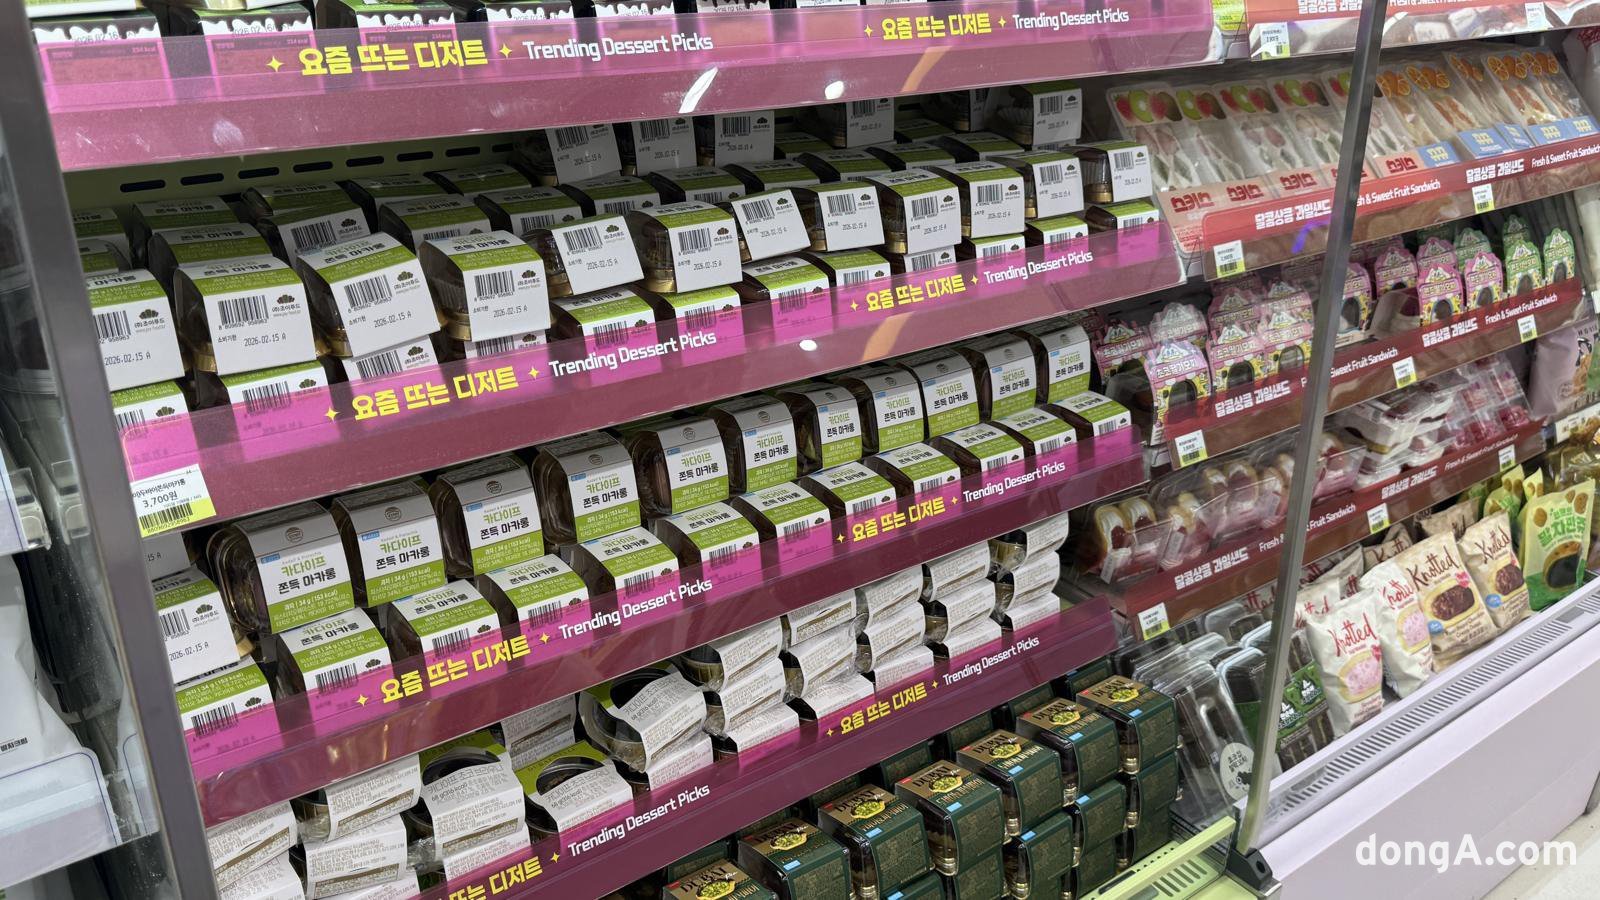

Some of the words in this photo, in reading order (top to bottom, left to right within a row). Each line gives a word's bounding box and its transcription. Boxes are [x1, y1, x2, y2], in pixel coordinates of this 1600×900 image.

[881, 17, 913, 40] 요즘
[916, 15, 946, 38] 뜨는
[949, 12, 992, 36] 디저트
[1012, 11, 1060, 31] Trending
[1060, 10, 1102, 28] Dessert
[1103, 9, 1129, 24] Picks
[298, 45, 353, 76] 요즘
[356, 43, 410, 72] 뜨는
[413, 39, 488, 69] 디저트
[522, 38, 599, 62] Trending
[602, 35, 670, 57] Dessert
[672, 32, 714, 53] Picks
[983, 265, 1028, 284] Trending
[1028, 255, 1067, 275] Dessert
[1067, 249, 1094, 266] Picks
[866, 290, 895, 312] 요즘
[895, 284, 925, 305] 뜨는
[925, 275, 967, 299] 디저트
[373, 311, 406, 329] 2026.02.15
[243, 333, 280, 348] 2026.02.15
[104, 352, 144, 367] 2026.02.15
[548, 350, 618, 378] Trending
[620, 336, 679, 364] Dessert
[678, 331, 717, 354] Picks
[351, 388, 400, 422] 요즘
[403, 380, 452, 411] 뜨는
[453, 365, 519, 401] 디저트
[753, 450, 768, 463] 쫀득
[768, 444, 790, 459] 마카롱
[756, 434, 785, 449] 카다이프
[679, 468, 694, 482] 쫀득
[696, 462, 719, 478] 마카롱
[681, 452, 712, 468] 카다이프
[586, 477, 621, 494] 카다이프
[963, 482, 1003, 503] Trending
[1004, 470, 1041, 494] Dessert
[1042, 462, 1065, 478] Picks
[583, 495, 600, 509] 쫀득
[602, 487, 628, 503] 마카롱
[480, 525, 499, 540] 쫀득
[501, 516, 530, 534] 마카롱
[483, 507, 522, 525] 카다이프
[852, 519, 878, 542] 요즘
[880, 511, 906, 532] 뜨는
[908, 496, 946, 523] 디저트
[1310, 516, 1326, 530] Fruit
[1326, 504, 1356, 523] Sandwich
[375, 555, 397, 570] 쫀득
[399, 545, 430, 563] 마카롱
[379, 535, 422, 555] 카다이프
[281, 556, 327, 577] 카다이프
[1406, 546, 1459, 590] Knotted
[278, 578, 300, 595] 쫀득
[303, 567, 336, 587] 마카롱
[437, 594, 468, 608] 마카롱
[558, 609, 621, 640] Trending
[622, 588, 678, 619] Dessert
[678, 578, 713, 602] Picks
[302, 618, 346, 635] 카다이프
[325, 622, 359, 638] 마카롱
[1329, 613, 1379, 657] Knotted
[168, 642, 203, 662] 2026.02.15
[943, 662, 982, 686] Trending
[981, 645, 1017, 668] Dessert
[1017, 636, 1040, 655] Picks
[380, 670, 424, 704] 요즘
[427, 658, 474, 688] 뜨는
[471, 634, 530, 669] 디저트
[840, 710, 865, 735] 요즘
[866, 700, 891, 721] 뜨는
[892, 681, 928, 711] 디저트
[567, 824, 626, 857] Trending
[626, 799, 677, 831] Dessert
[678, 783, 710, 809] Picks
[489, 856, 543, 896] 디저트
